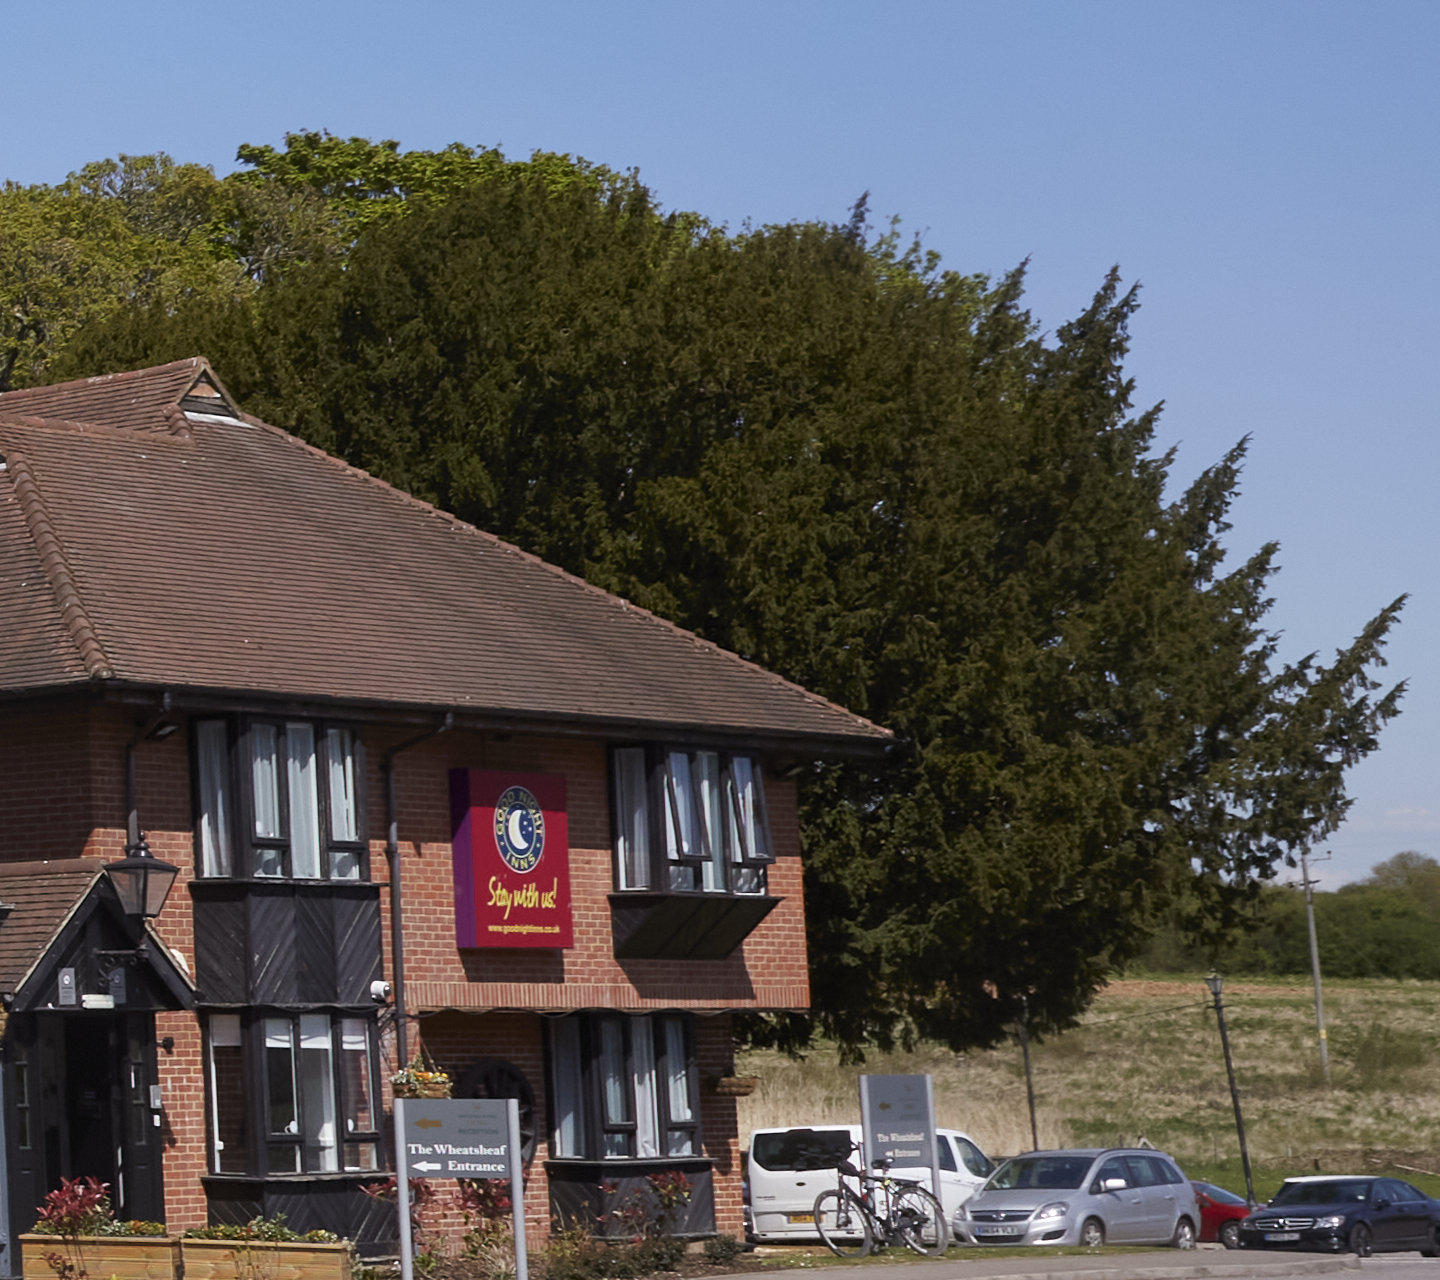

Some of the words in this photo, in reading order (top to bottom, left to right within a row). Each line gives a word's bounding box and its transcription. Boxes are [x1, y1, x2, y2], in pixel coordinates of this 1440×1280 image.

[495, 790, 516, 836] GOOD
[519, 790, 544, 835] NIGHT
[506, 851, 537, 870] INNS
[487, 876, 513, 920] Stay
[513, 882, 539, 908] with
[541, 877, 558, 909] us!
[407, 1143, 433, 1155] The
[433, 1143, 508, 1156] Wheatsheaf
[447, 1160, 506, 1172] Entrance
